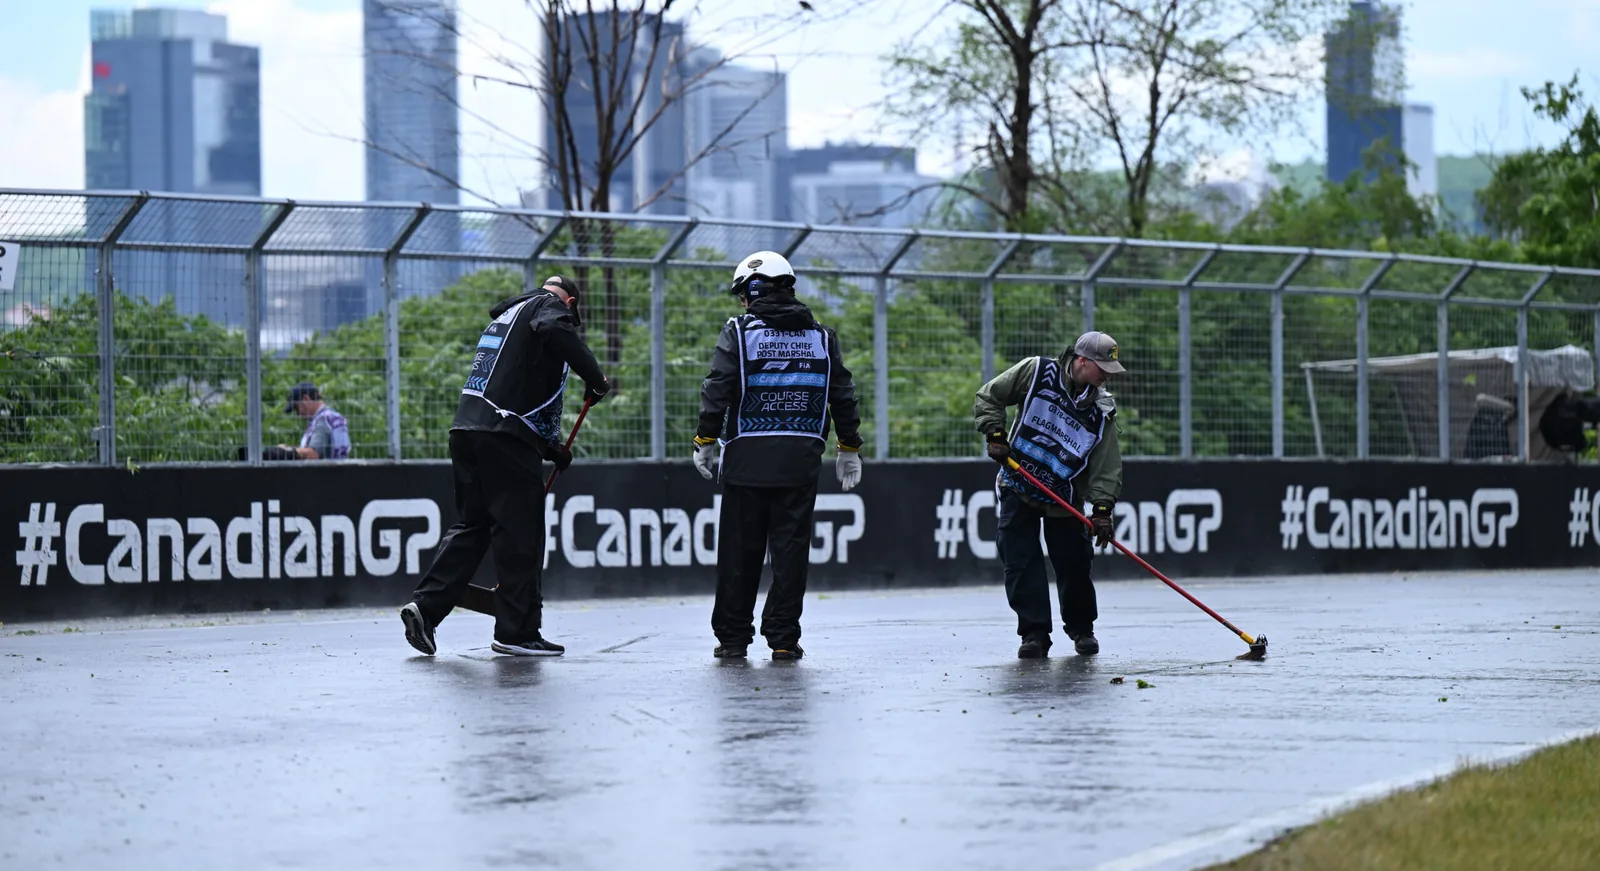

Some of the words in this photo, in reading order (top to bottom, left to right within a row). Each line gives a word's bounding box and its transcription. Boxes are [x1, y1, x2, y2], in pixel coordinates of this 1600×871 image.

[758, 342, 789, 350] DEPUTY
[790, 342, 813, 350] CHIEF
[757, 350, 777, 358] POST
[778, 350, 816, 358] MARSHAL
[760, 391, 809, 401] COURSE
[760, 402, 808, 412] ACCESS
[1020, 459, 1056, 484] COURSE
[1279, 485, 1519, 550] #CanadianGP
[16, 498, 441, 586] #CanadianGP
